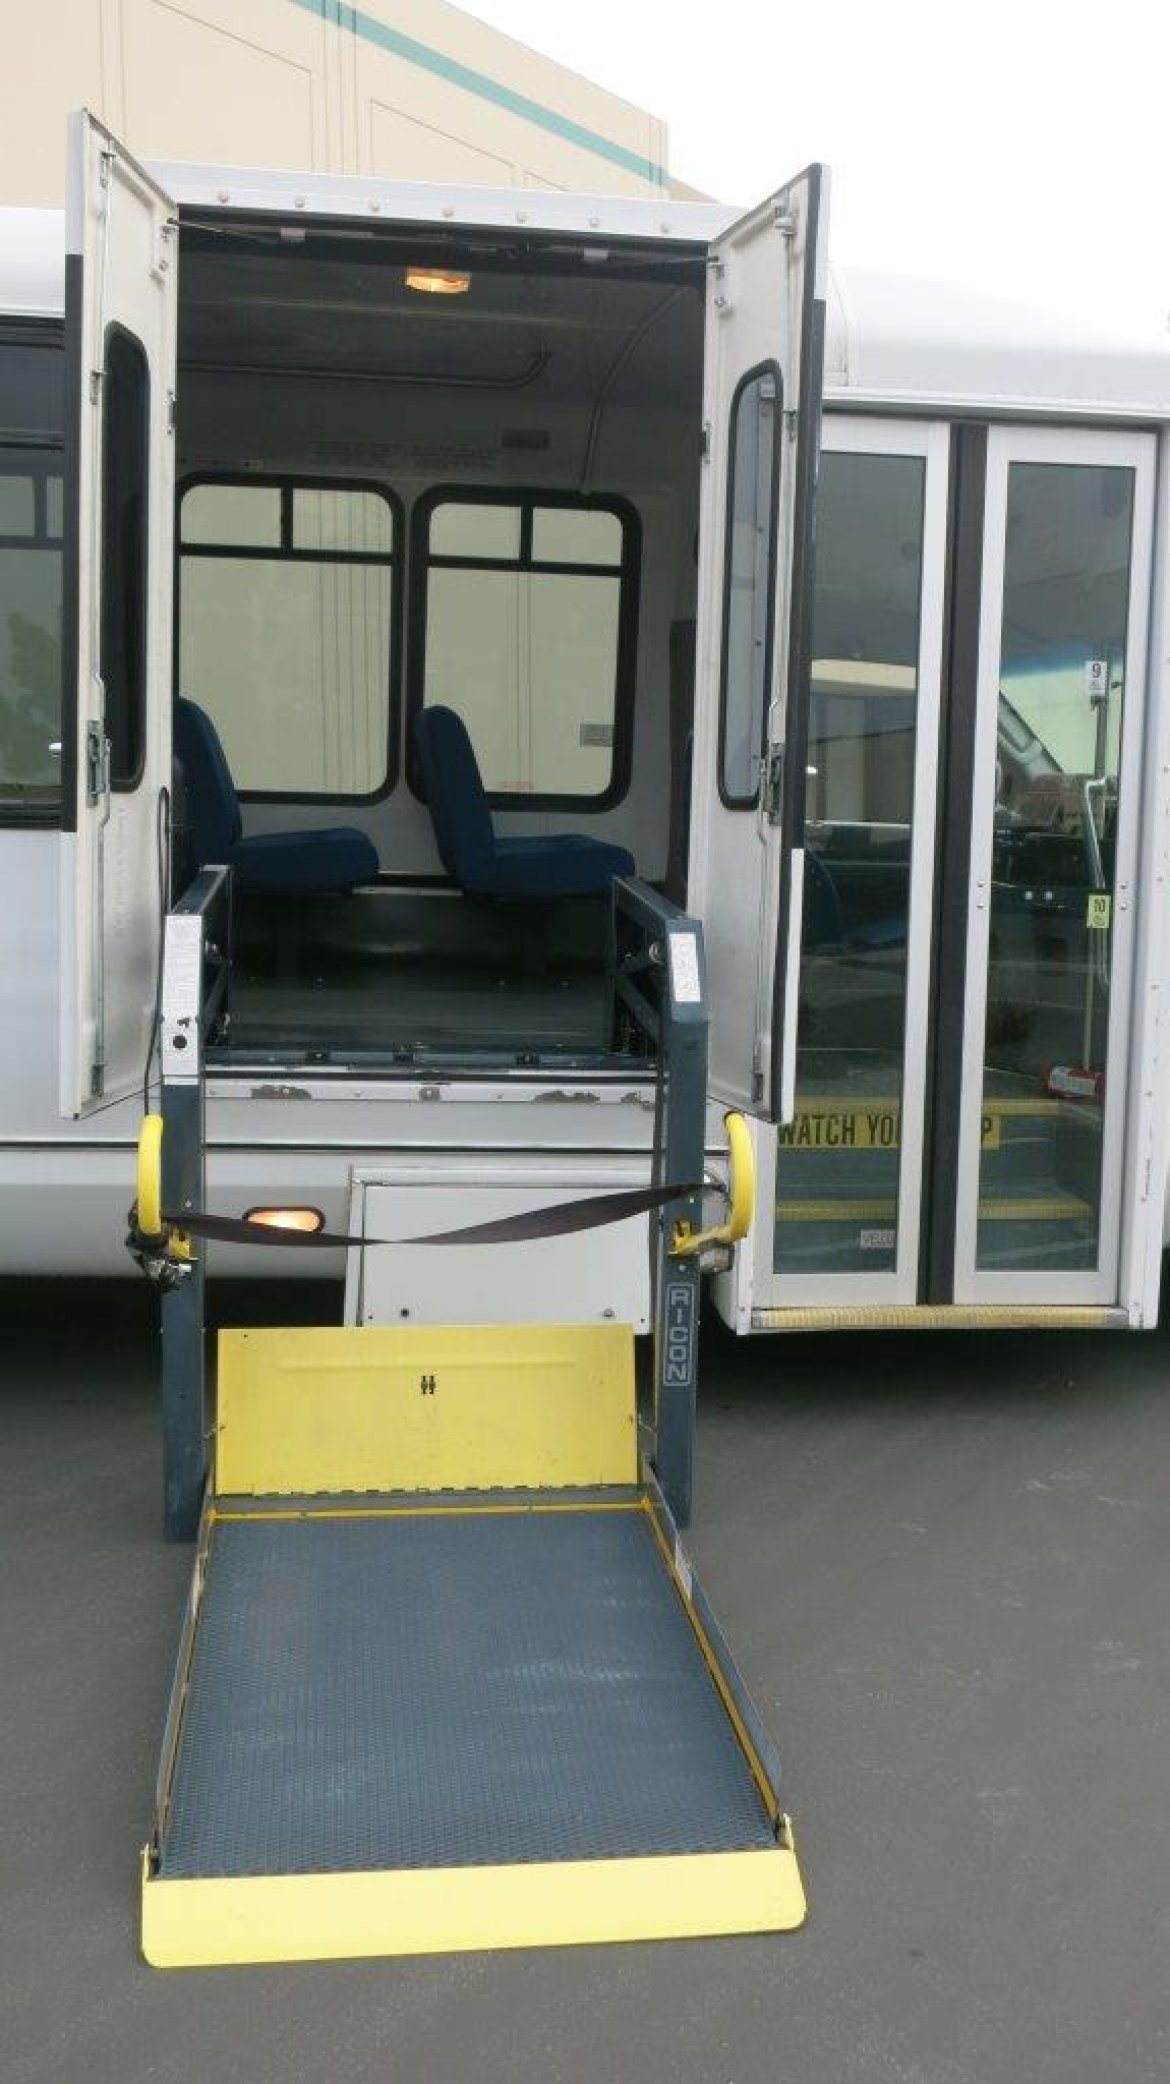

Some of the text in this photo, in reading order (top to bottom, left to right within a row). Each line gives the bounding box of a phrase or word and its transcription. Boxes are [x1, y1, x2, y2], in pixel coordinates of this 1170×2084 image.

[1092, 663, 1102, 678] 9
[1094, 898, 1106, 913] 10
[777, 1114, 856, 1146] WATCH
[666, 1288, 690, 1381] RICON
